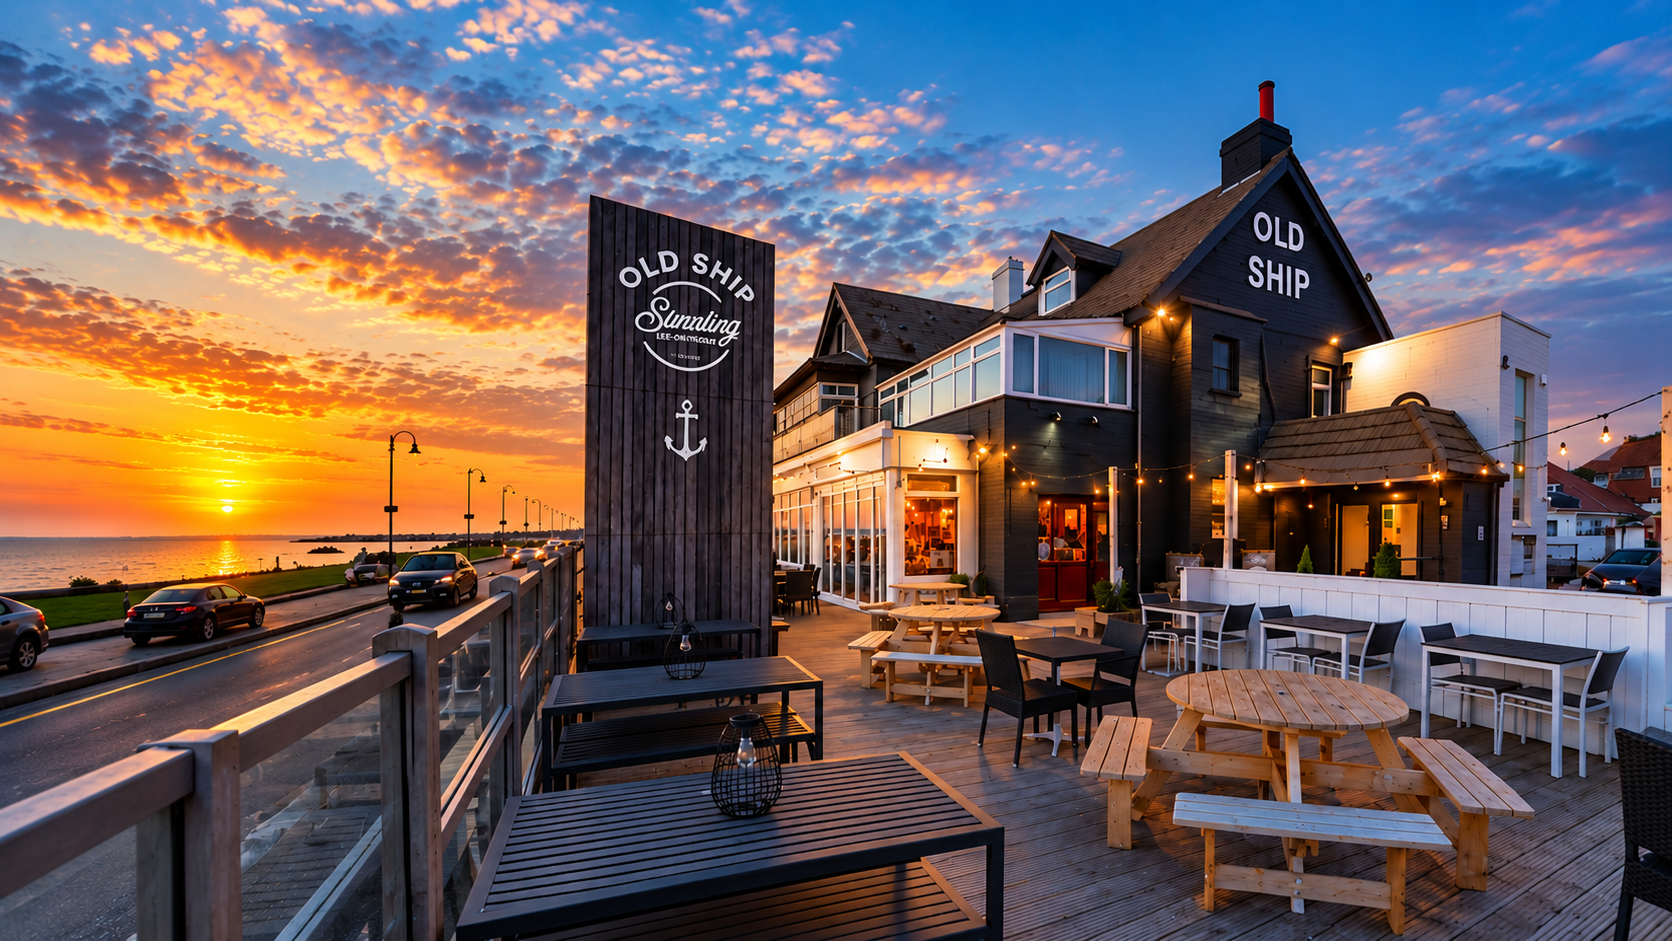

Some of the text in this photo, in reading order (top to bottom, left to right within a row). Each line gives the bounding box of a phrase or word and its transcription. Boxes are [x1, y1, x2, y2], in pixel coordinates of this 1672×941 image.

[1253, 211, 1304, 252] OLD
[619, 250, 755, 302] OLD SHIP
[1248, 255, 1310, 299] SHIP
